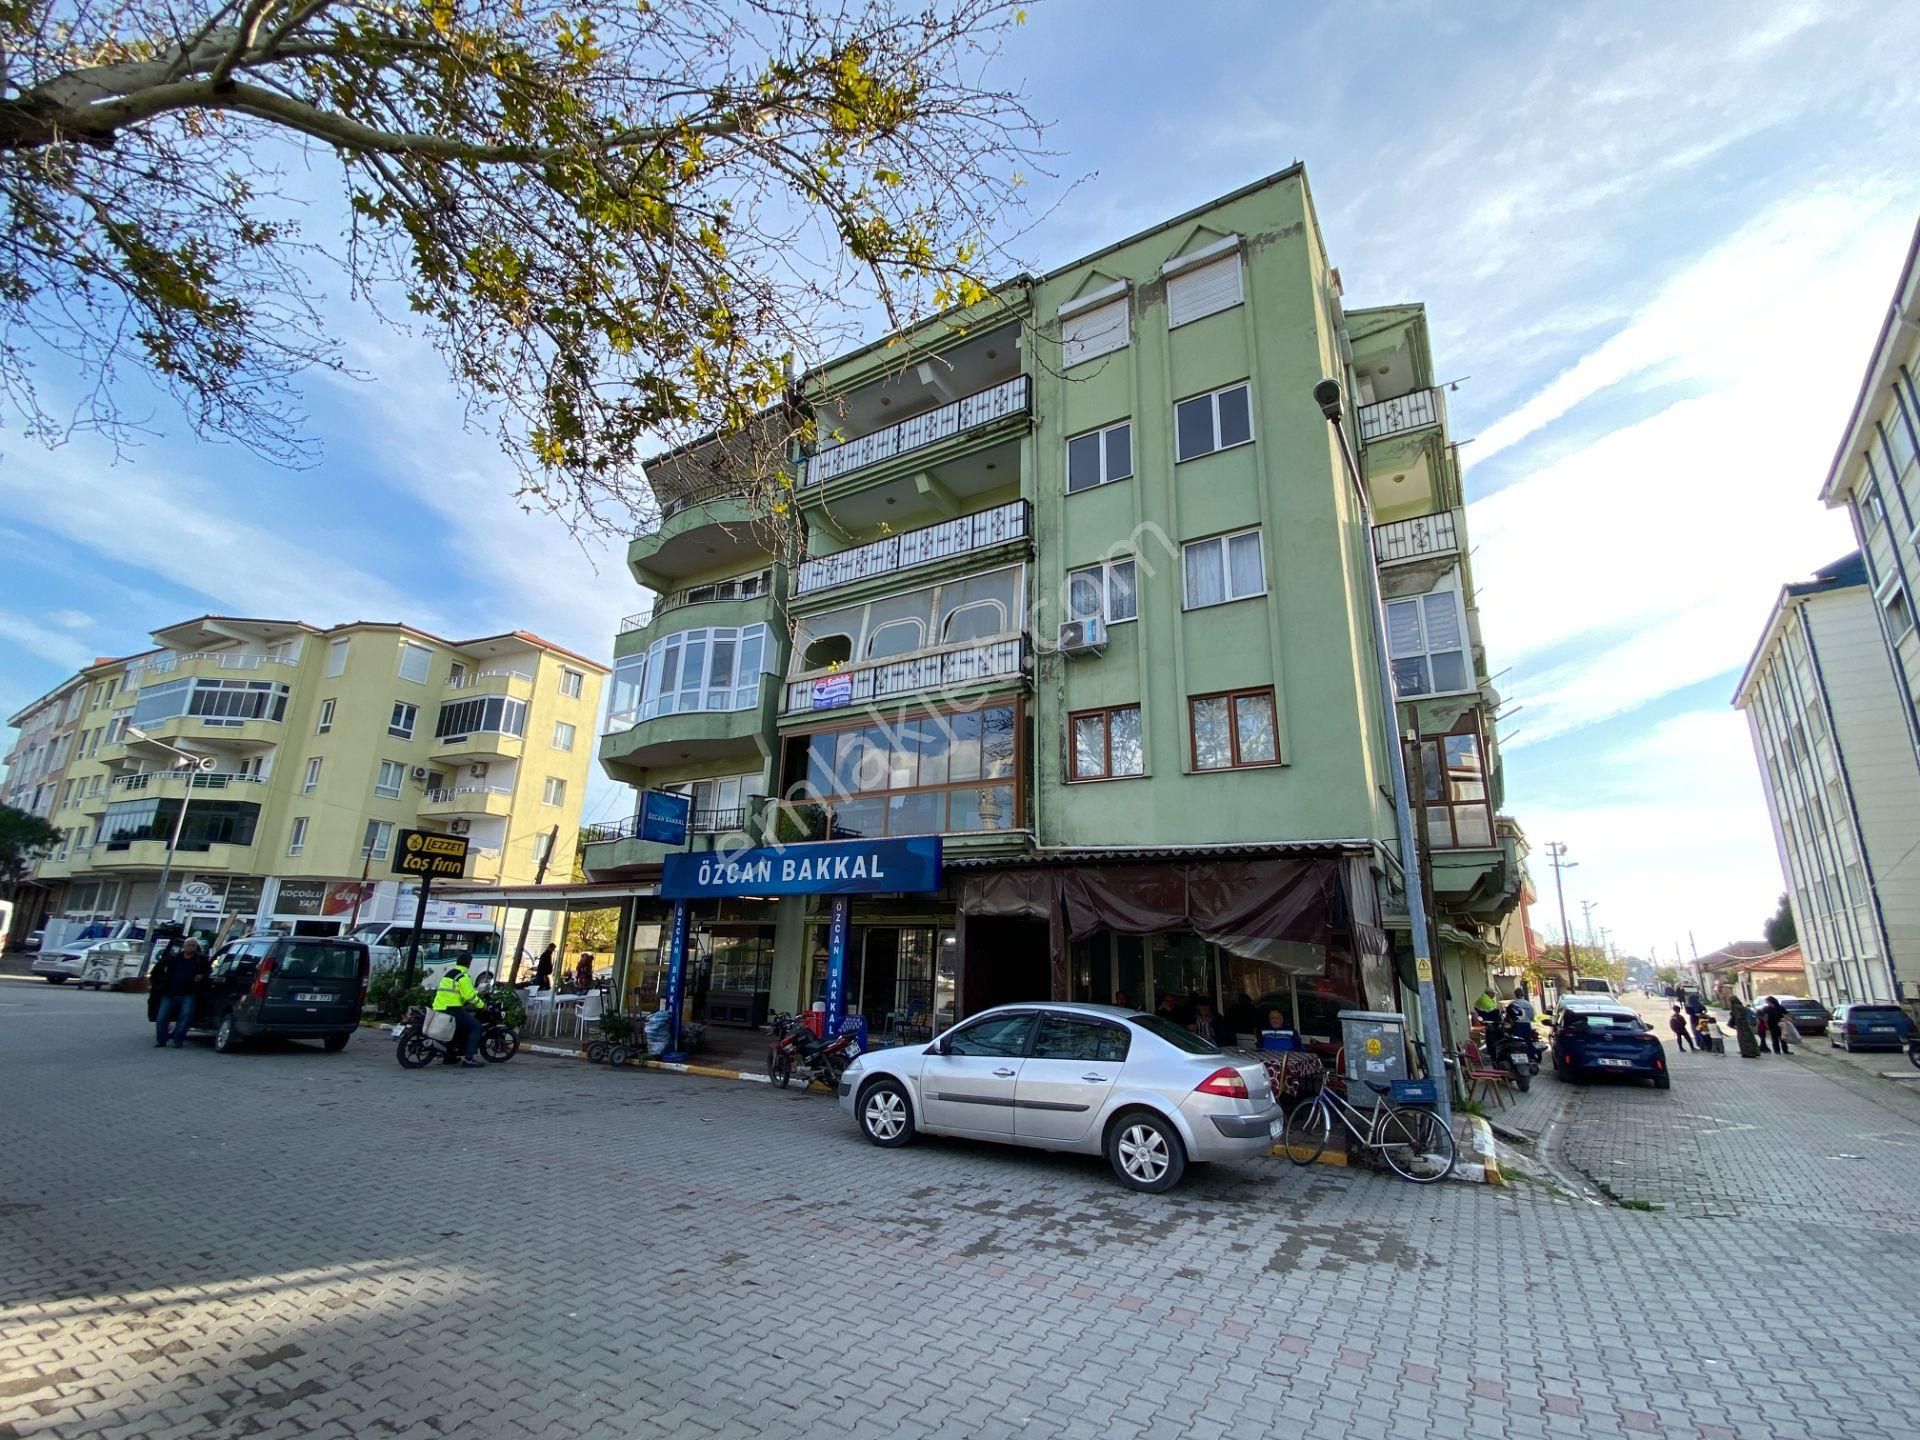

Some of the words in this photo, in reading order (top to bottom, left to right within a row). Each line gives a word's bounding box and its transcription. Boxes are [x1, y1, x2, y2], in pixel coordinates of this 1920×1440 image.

[425, 838, 463, 853] LEZZET
[402, 853, 430, 871] taş
[698, 860, 772, 886] ÖZCAN
[781, 854, 885, 882] BAKKAL
[280, 889, 323, 898] KOÇOĞLU
[299, 899, 320, 908] YAPI
[674, 907, 683, 954] ÖZCAN
[833, 901, 842, 955] ÖZCAN
[828, 968, 838, 1035] BAKKAL
